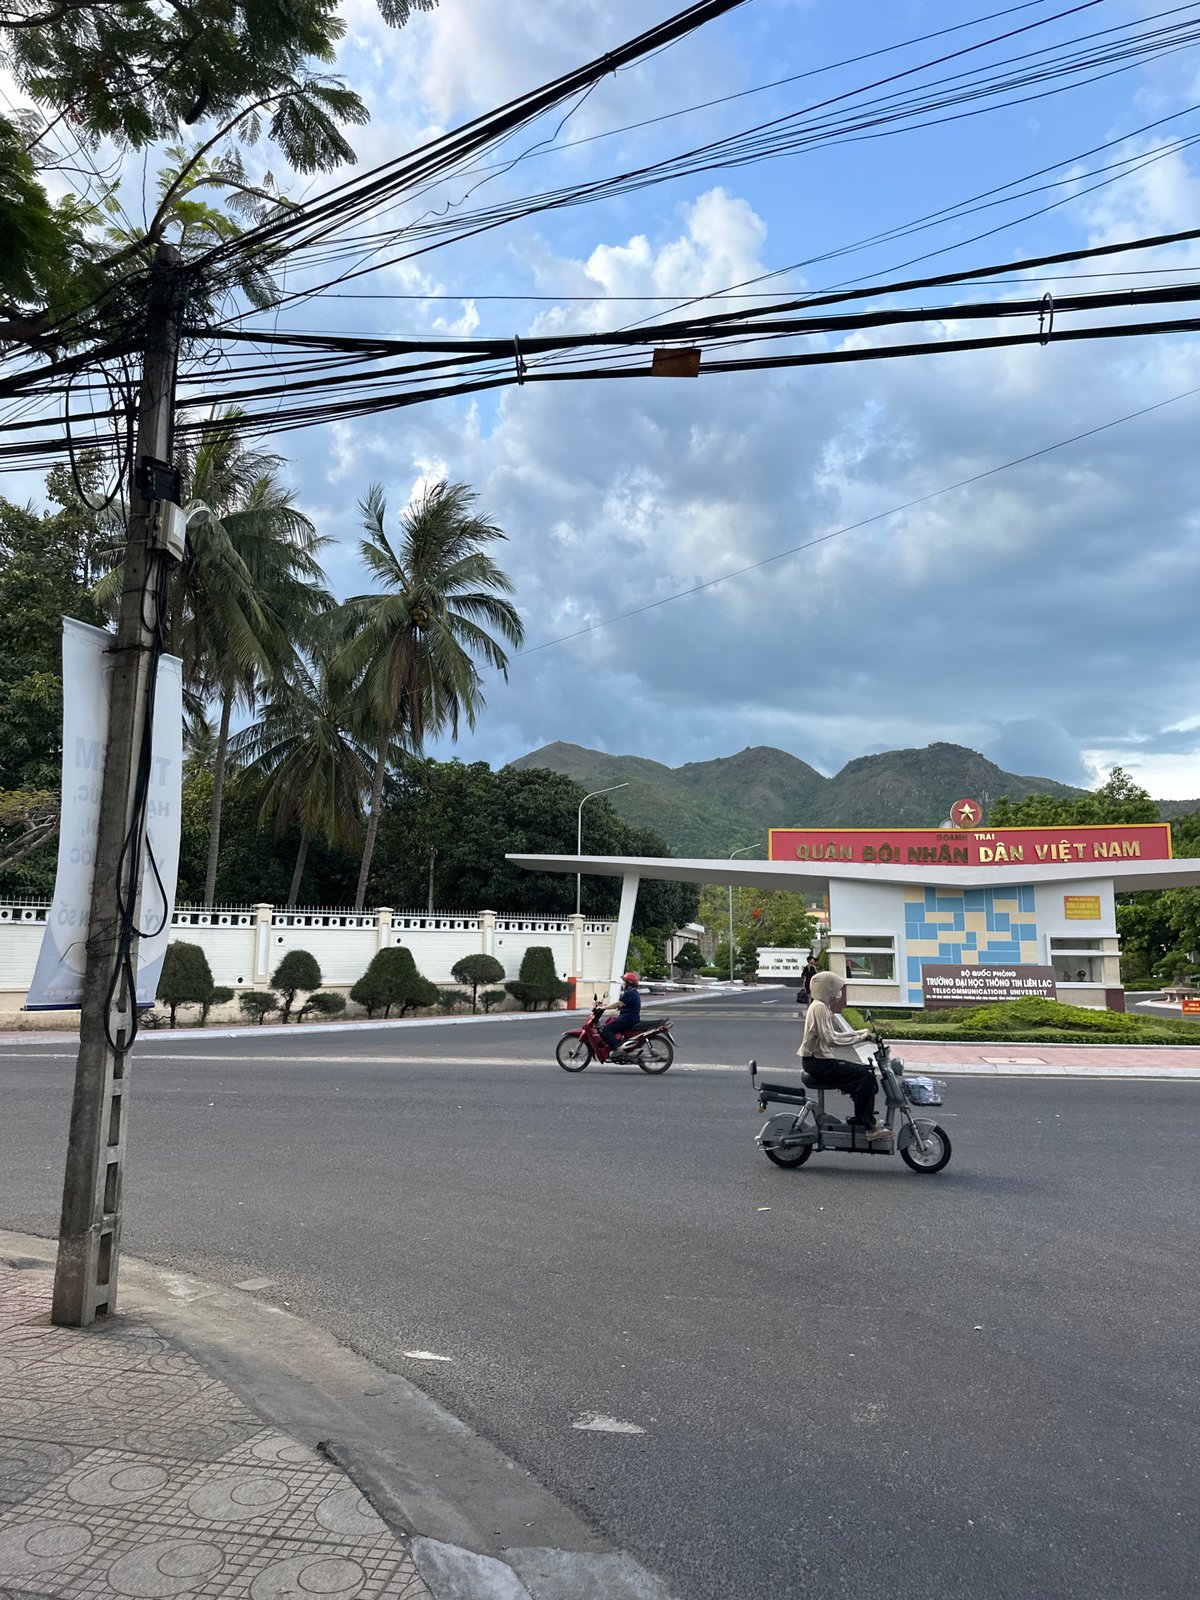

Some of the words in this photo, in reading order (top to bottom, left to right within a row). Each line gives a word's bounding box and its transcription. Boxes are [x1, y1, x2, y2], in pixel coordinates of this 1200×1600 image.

[974, 833, 995, 841] TRAI
[796, 841, 853, 861] QUÂN
[862, 842, 900, 864] ĐỘI
[908, 843, 968, 864] NHÂN
[979, 842, 1024, 863] DÂN
[1034, 839, 1087, 863] VIỆT
[1093, 840, 1141, 858] NAM
[961, 968, 970, 977] BỘ
[972, 968, 991, 977] QUỐC
[993, 969, 1016, 977] PHÒNG
[926, 976, 954, 986] TRƯỜNG
[955, 978, 967, 988] ĐẠI
[968, 978, 984, 989] HỌC
[985, 977, 1010, 987] THÔNG
[1011, 979, 1022, 988] TIN
[1023, 977, 1038, 988] LIÊN
